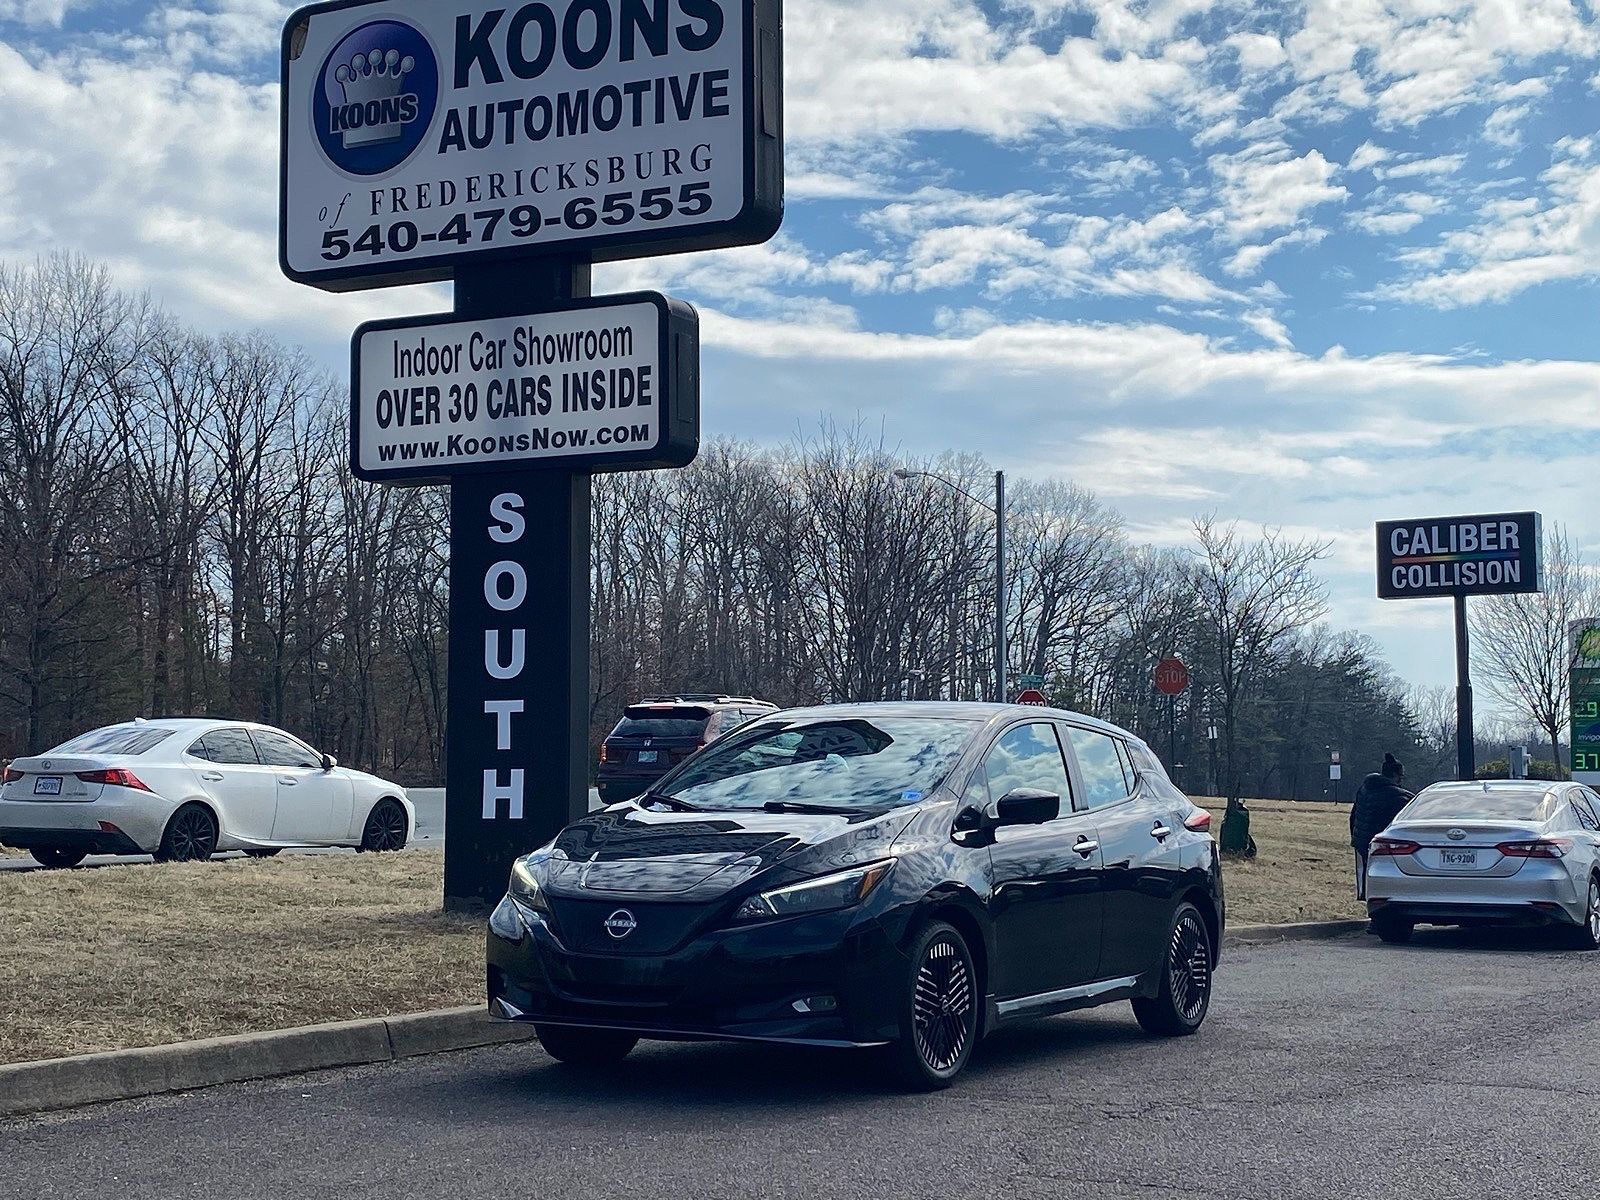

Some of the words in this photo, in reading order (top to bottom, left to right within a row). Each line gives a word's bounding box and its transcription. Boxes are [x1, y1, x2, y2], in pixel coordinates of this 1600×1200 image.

[453, 0, 725, 90] KOONS
[330, 94, 418, 133] KOONS
[437, 69, 730, 155] AUTOMOTIVE
[318, 192, 352, 229] of
[370, 143, 714, 217] FREDERICKSBURG
[320, 182, 713, 260] 540-479-6555
[393, 337, 463, 378] Indoor
[469, 331, 506, 372] Car
[513, 325, 634, 368] Showroom
[376, 385, 441, 430] OVER
[448, 382, 478, 424] 30
[486, 375, 552, 420] CARS
[562, 365, 652, 413] INSIDE
[1390, 521, 1520, 557] CALIBER
[1391, 559, 1521, 589] COLLISION
[482, 492, 528, 820] SOUTH
[1157, 670, 1186, 684] STOP
[604, 919, 637, 928] NISSAN
